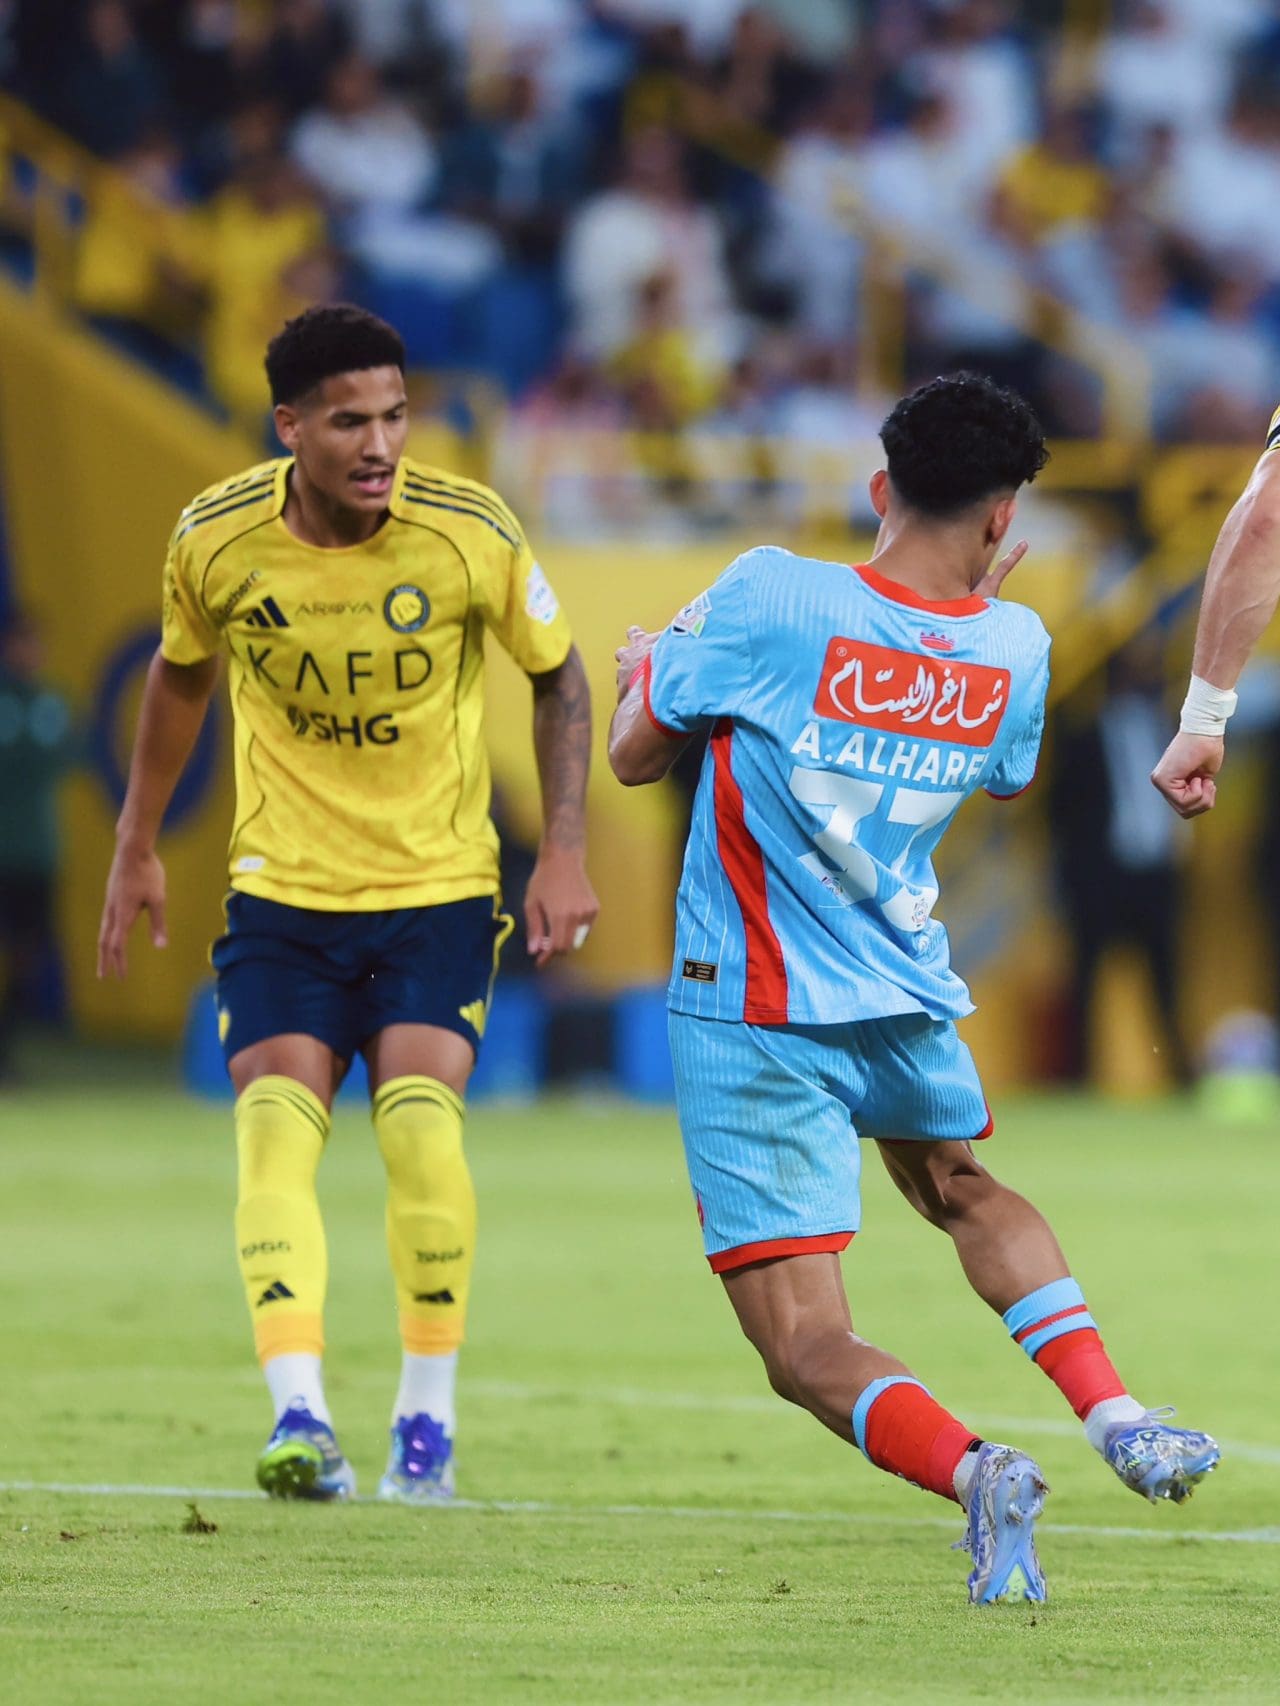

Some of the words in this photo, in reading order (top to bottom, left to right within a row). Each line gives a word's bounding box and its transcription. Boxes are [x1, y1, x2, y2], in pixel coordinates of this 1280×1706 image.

[247, 644, 432, 695] KAFD
[929, 666, 1004, 730] شماغ
[309, 711, 400, 747] SHG
